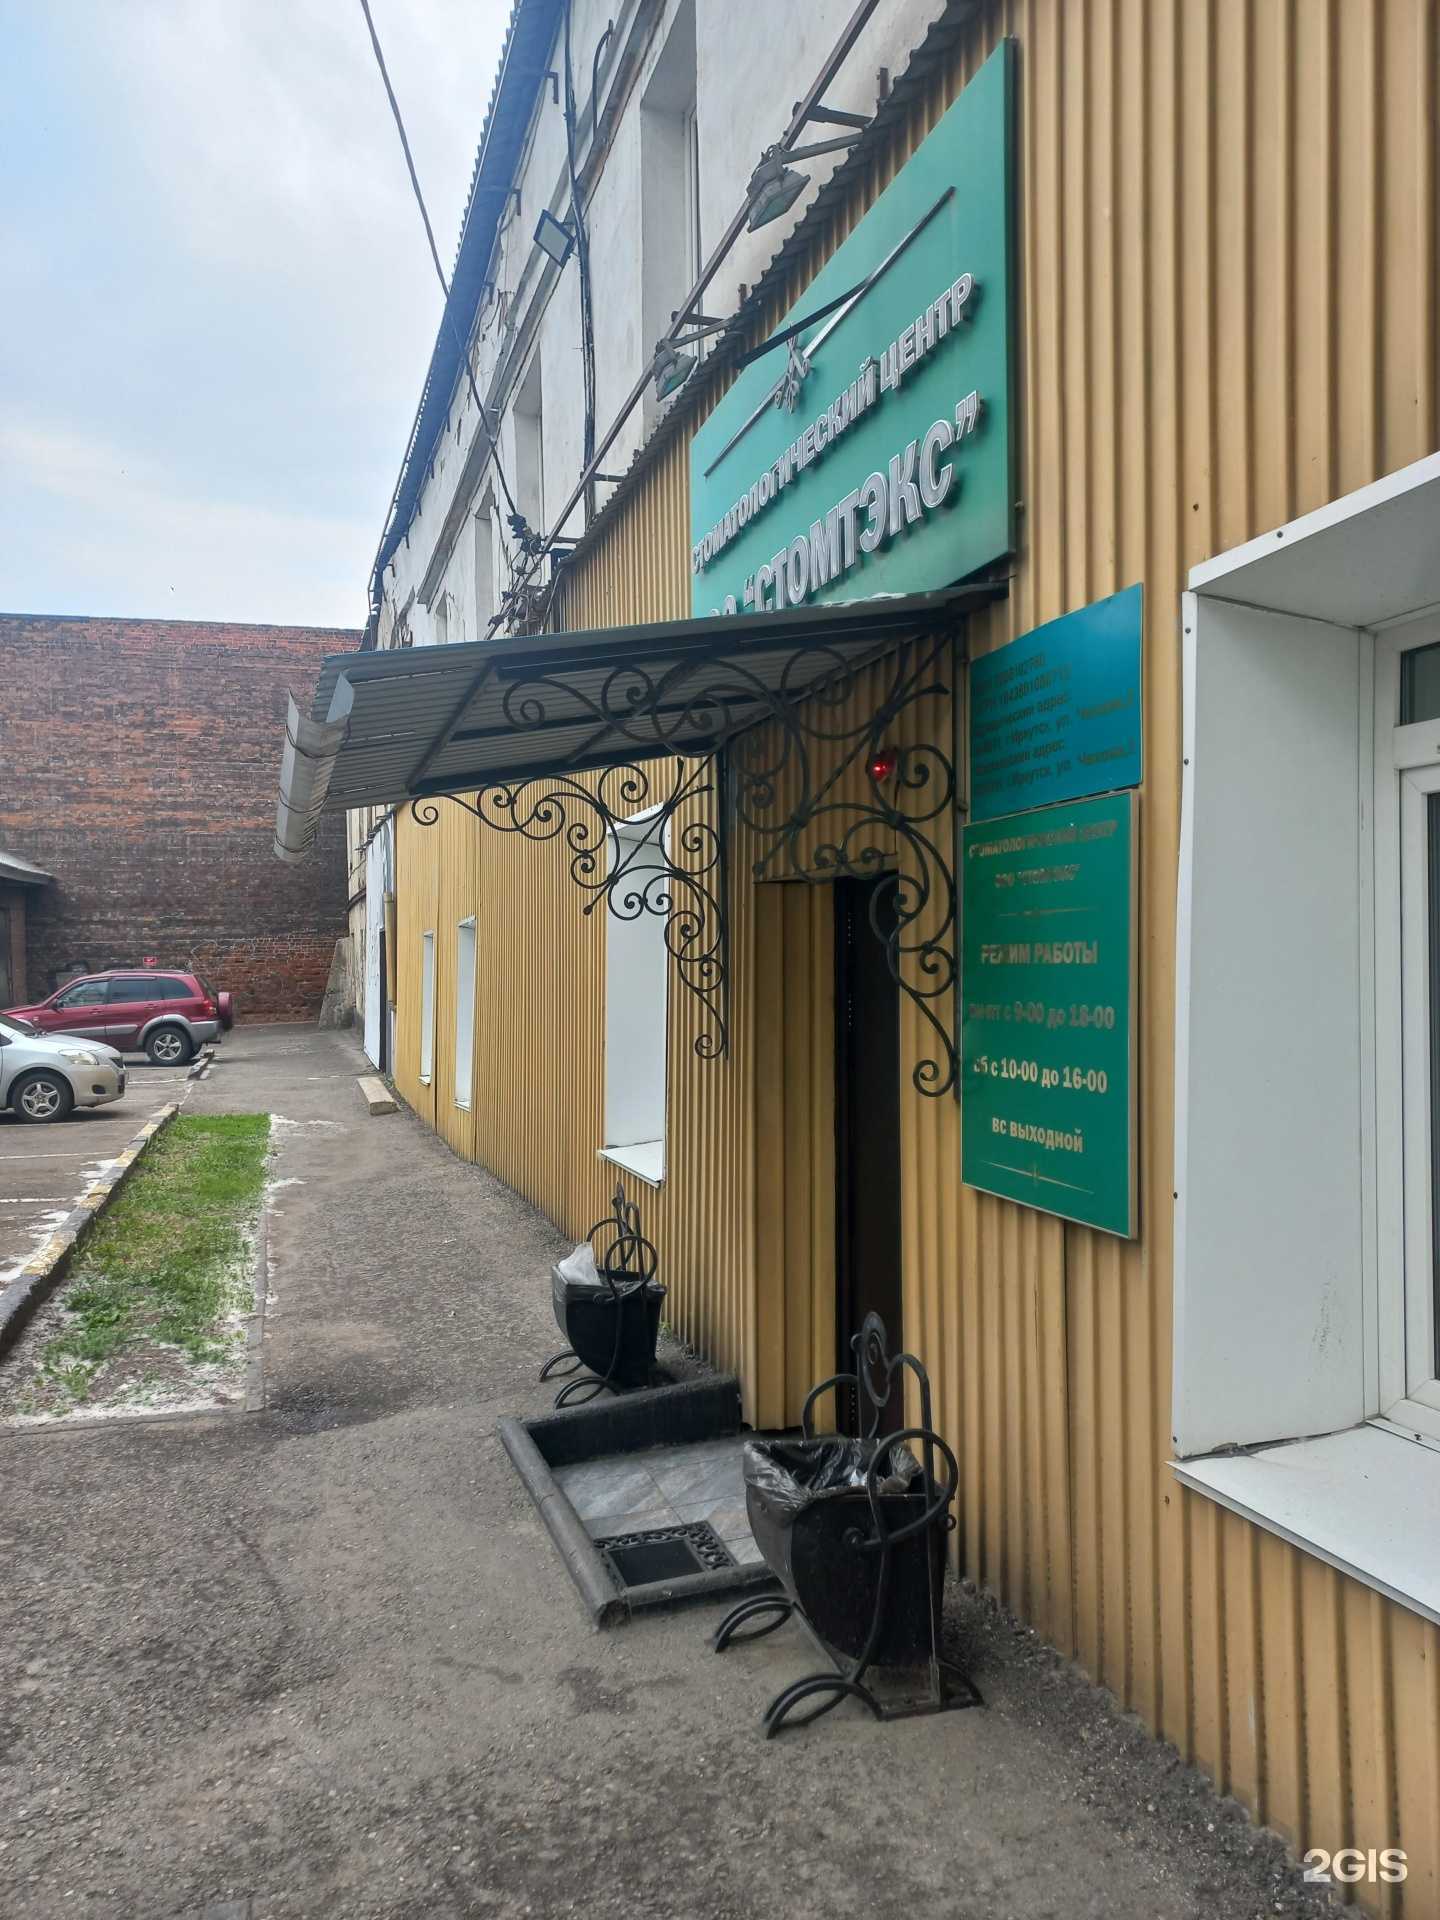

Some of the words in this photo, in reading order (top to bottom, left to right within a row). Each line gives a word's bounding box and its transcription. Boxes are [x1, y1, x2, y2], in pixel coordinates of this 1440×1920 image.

[692, 356, 877, 577] СТОМАТОЛОГИЧЕСКИЙ
[880, 271, 977, 393] ЦЕНТР
[968, 826, 1078, 859] СОМАТОЛОГИ
[1034, 939, 1098, 964] РАБОТЫ
[1048, 1007, 1066, 1029] до
[1069, 1003, 1116, 1030] 18-00
[990, 1061, 999, 1078] с
[1000, 1057, 1039, 1083] 10-00
[1041, 1067, 1060, 1089] до
[1063, 1065, 1108, 1094] 16-00
